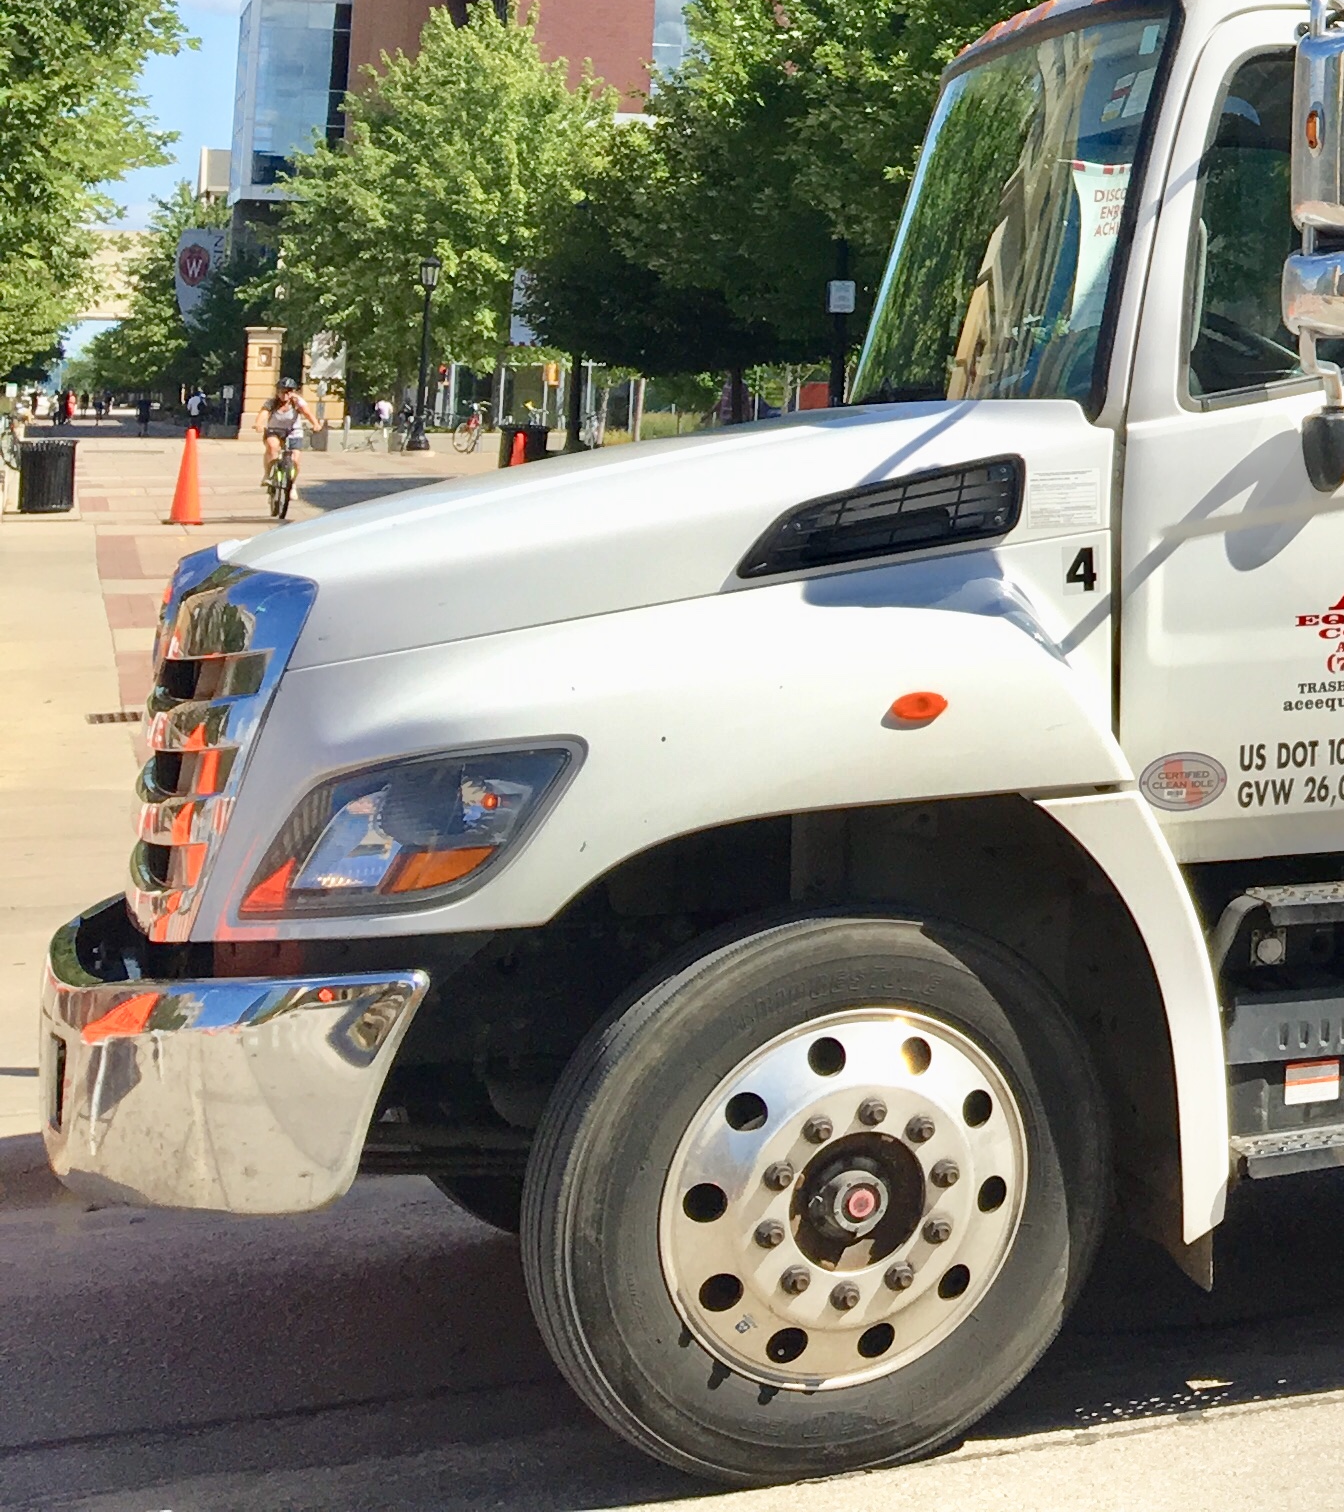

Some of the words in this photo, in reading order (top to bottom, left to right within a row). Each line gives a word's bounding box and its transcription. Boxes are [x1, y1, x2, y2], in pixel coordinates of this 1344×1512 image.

[1094, 187, 1126, 203] DISCO
[1094, 223, 1120, 237] ACHI
[187, 259, 202, 278] W
[1066, 547, 1097, 591] 4
[1240, 743, 1266, 771] US
[1277, 740, 1319, 769] DOT
[1158, 770, 1210, 780] CERTIFIED
[1152, 781, 1187, 789] CLEAN
[1191, 779, 1214, 788] IDLE
[1237, 778, 1294, 808] GVW
